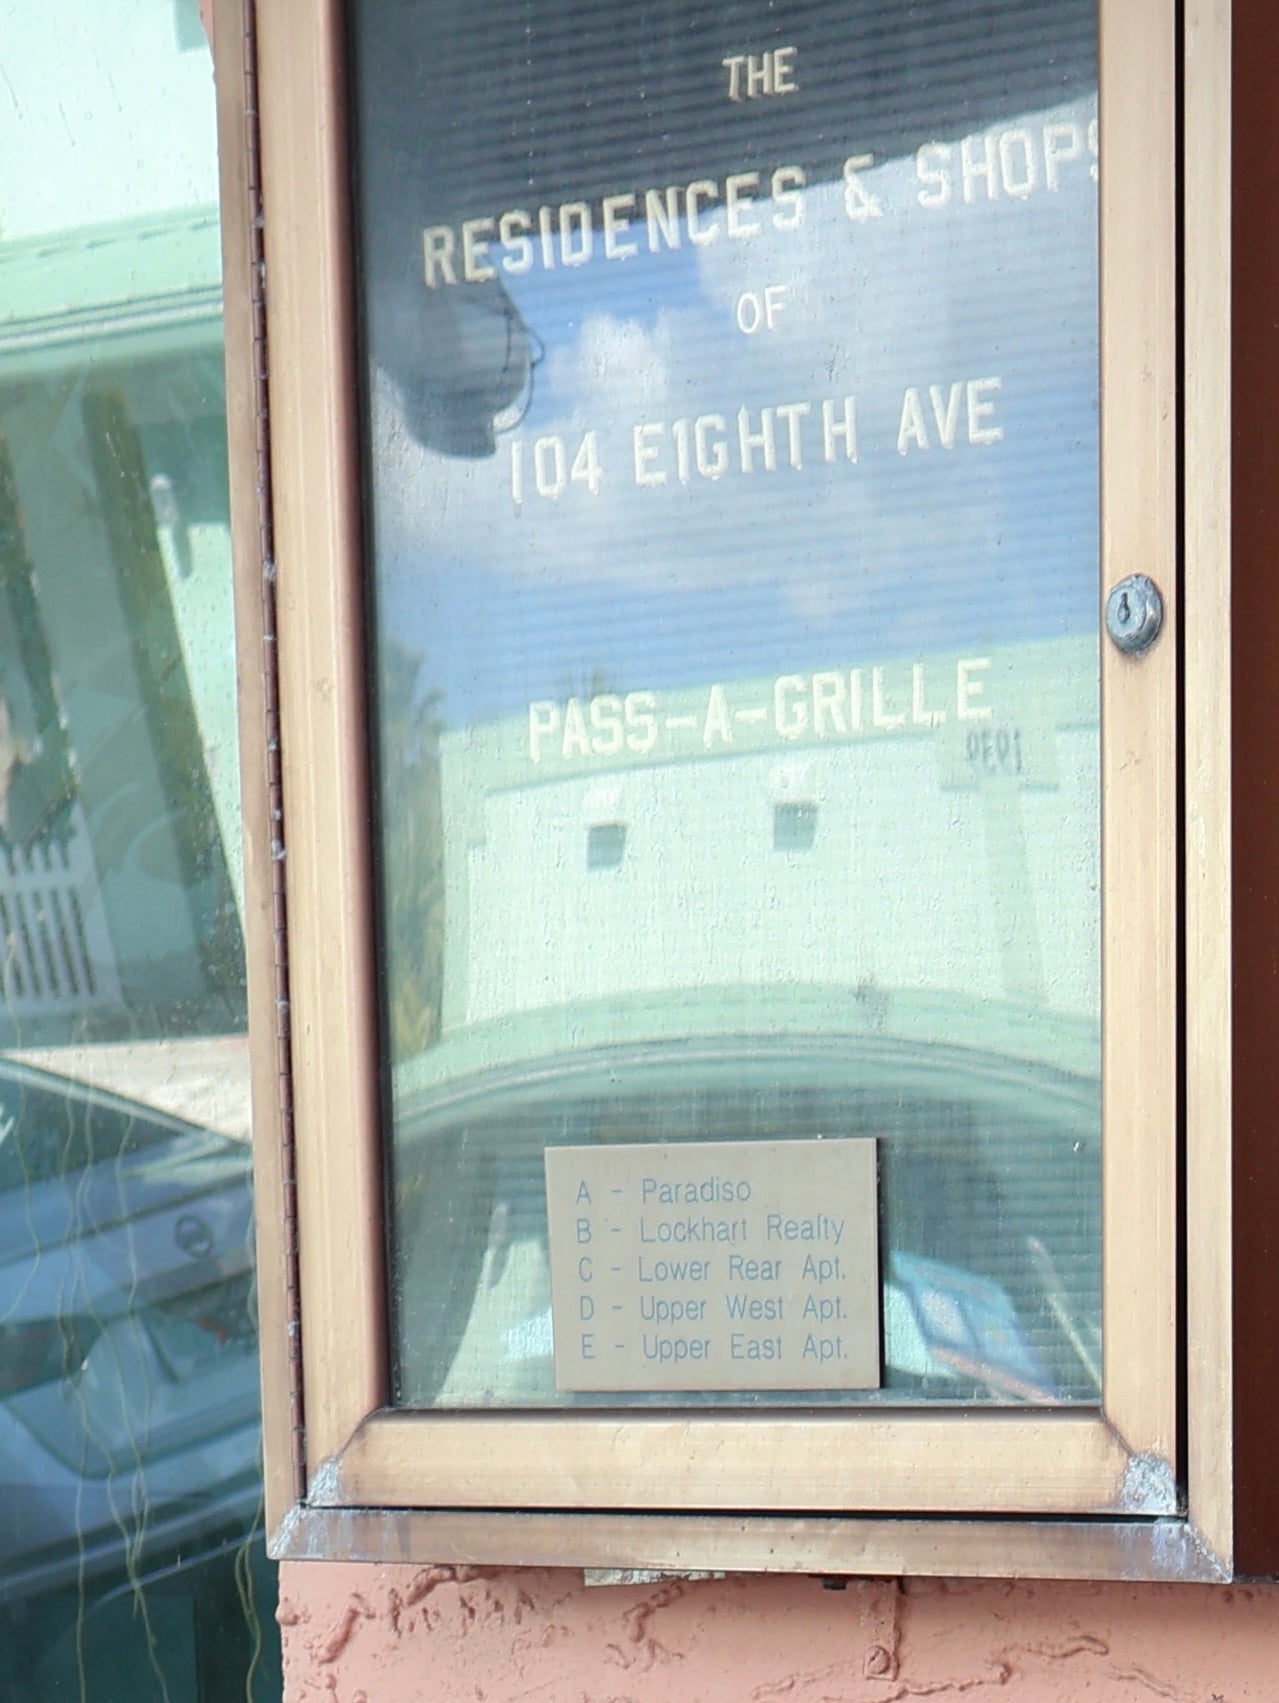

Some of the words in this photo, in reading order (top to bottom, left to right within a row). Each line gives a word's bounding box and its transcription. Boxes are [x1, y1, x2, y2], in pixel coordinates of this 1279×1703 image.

[722, 47, 799, 101] THE
[421, 167, 809, 290] RESIDENCES
[842, 156, 886, 219] &
[735, 287, 790, 334] OF
[897, 376, 1003, 456] AVE
[528, 659, 993, 763] PASS-A-GRILLE
[576, 1181, 592, 1204] A
[642, 1177, 752, 1204] Paradiso
[576, 1219, 592, 1243] B
[640, 1216, 747, 1244] Lockhart
[767, 1214, 845, 1245] Realty
[578, 1258, 593, 1283] C
[638, 1257, 709, 1282] Lower
[729, 1256, 782, 1280] Rear
[802, 1255, 846, 1287] Apt.
[579, 1297, 595, 1321] D
[640, 1296, 706, 1328] Upper
[726, 1295, 783, 1320] West
[802, 1294, 847, 1326] Apt.
[581, 1336, 594, 1360] E
[642, 1335, 710, 1367] Upper
[730, 1335, 782, 1360] East
[802, 1334, 847, 1366] Apt.
